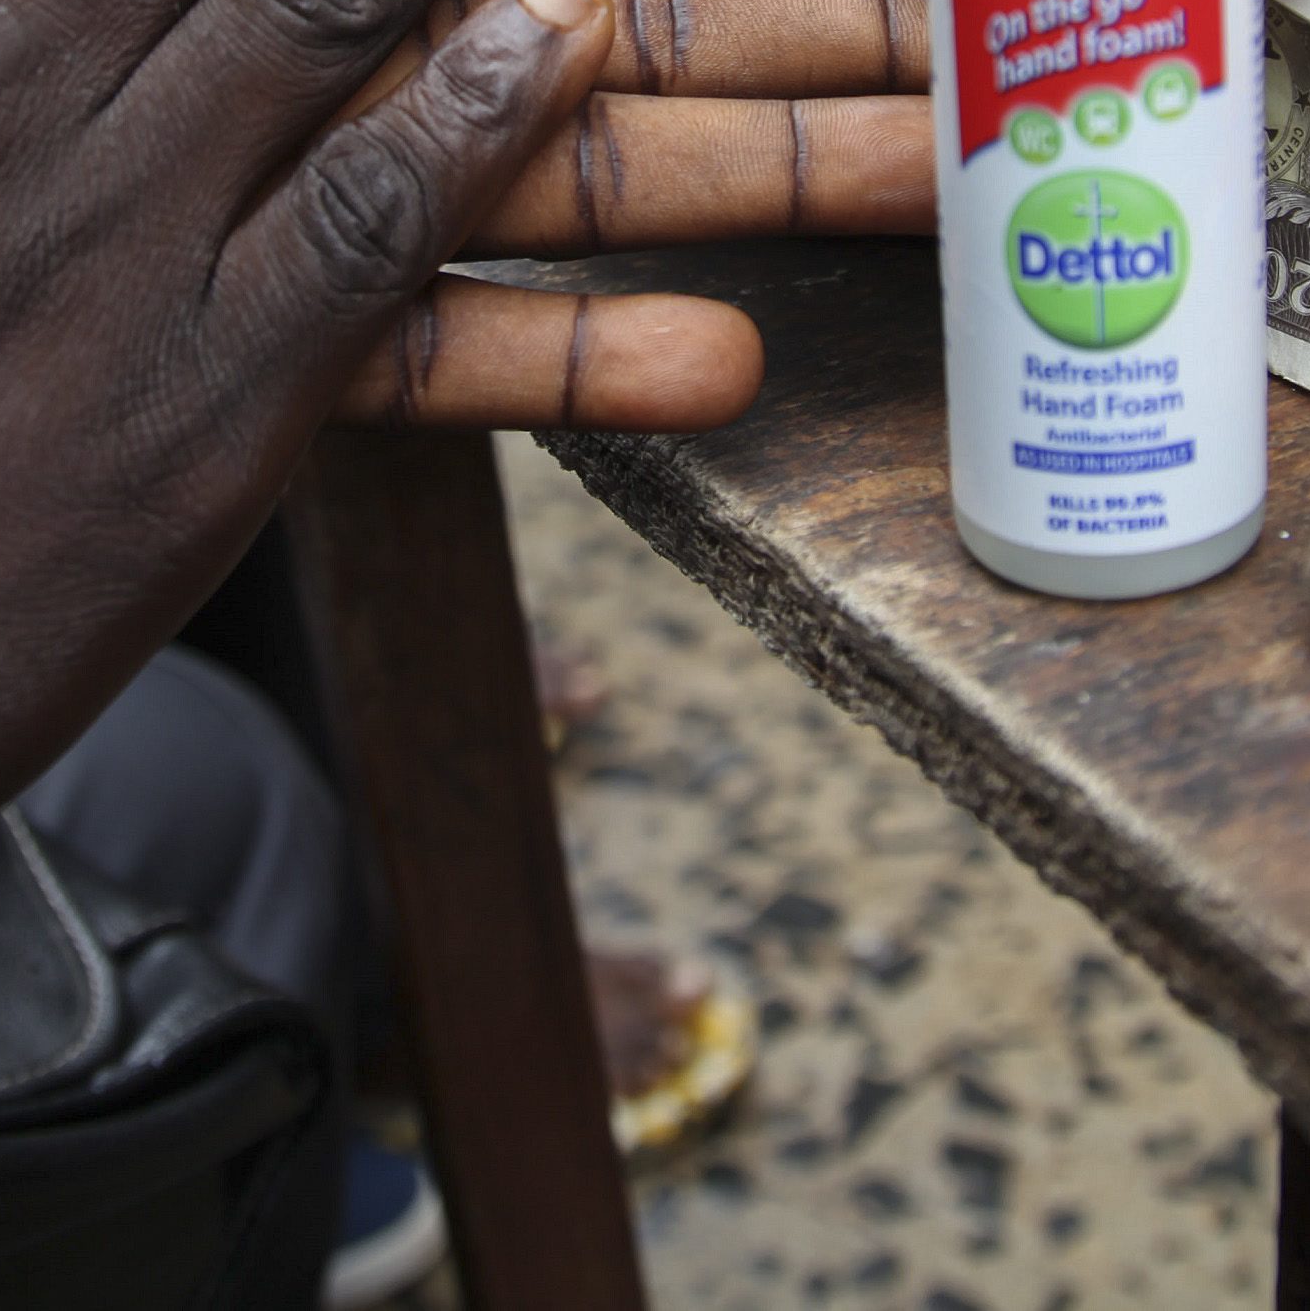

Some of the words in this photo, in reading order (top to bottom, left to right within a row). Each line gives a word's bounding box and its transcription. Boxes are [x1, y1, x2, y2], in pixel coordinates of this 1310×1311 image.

[985, 10, 1029, 54] On
[993, 27, 1080, 94] hand
[1082, 5, 1186, 66] foam!
[1265, 126, 1305, 177] CENTR
[1018, 228, 1173, 283] Dettol
[1025, 355, 1179, 385] Refreshing
[1022, 388, 1097, 419] Hand
[1105, 391, 1185, 418] Foam
[1047, 423, 1167, 443] Antibacterial
[1039, 451, 1079, 470] USED
[1084, 455, 1100, 470] IN
[1103, 446, 1188, 470] HOSPITALS
[1049, 494, 1099, 512] KILLS
[1048, 517, 1070, 532] OF
[1077, 515, 1168, 533] BACTERIA
